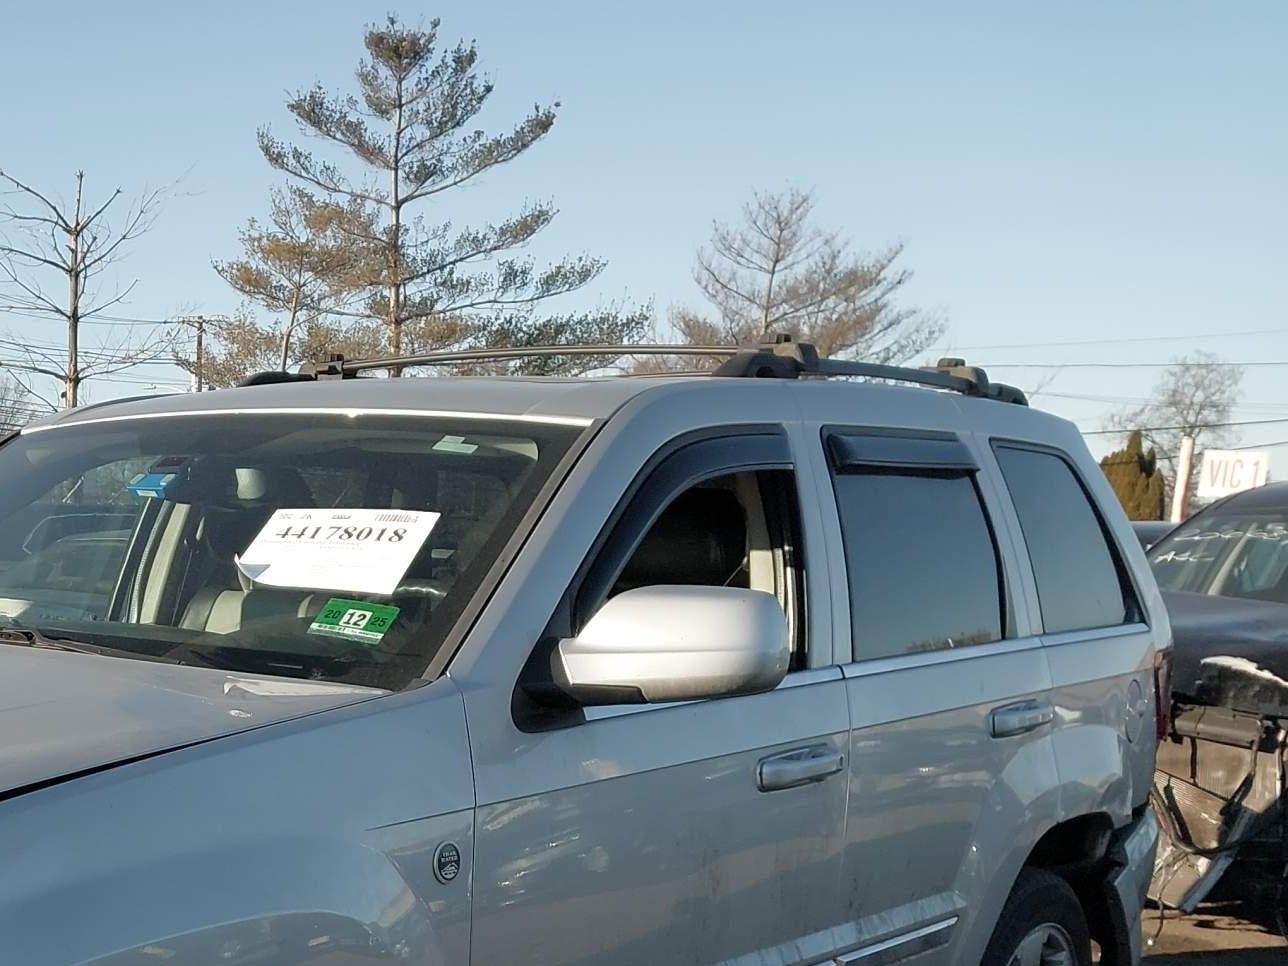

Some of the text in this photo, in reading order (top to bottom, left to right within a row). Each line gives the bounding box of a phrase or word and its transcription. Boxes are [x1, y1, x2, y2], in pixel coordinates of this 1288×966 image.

[1209, 458, 1244, 489] VIC
[275, 525, 408, 543] 44178018
[324, 609, 388, 628] 20 12 25
